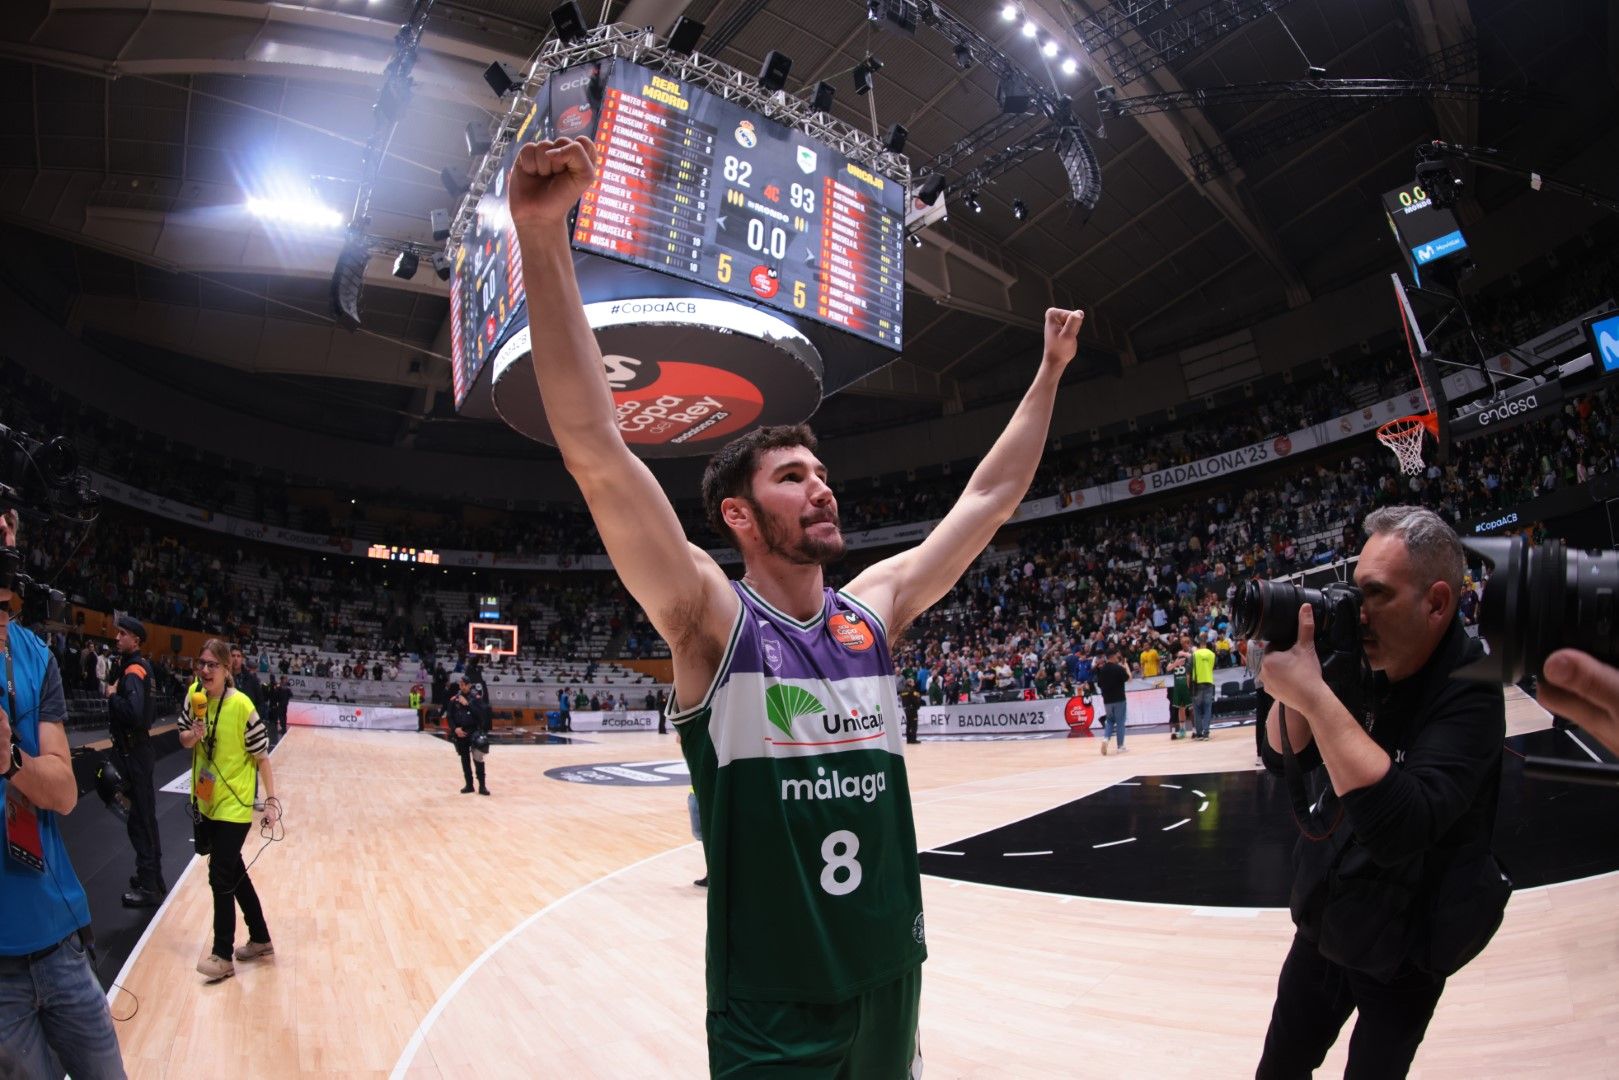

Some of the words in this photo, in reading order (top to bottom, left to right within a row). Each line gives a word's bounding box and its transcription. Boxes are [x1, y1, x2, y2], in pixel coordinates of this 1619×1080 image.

[642, 85, 689, 111] MADRID
[651, 76, 681, 96] REAL
[723, 155, 753, 188] 82
[789, 182, 815, 214] 93
[747, 218, 786, 260] 0.0
[717, 253, 732, 283] 5
[610, 301, 697, 316] #CopaACB
[793, 280, 806, 309] 5
[619, 394, 684, 432] Copa
[667, 395, 724, 423] Rey
[1478, 394, 1538, 426] endesa
[1475, 513, 1518, 533] #CopaACB
[601, 717, 651, 728] #CopaACB
[822, 704, 883, 735] Unicaj
[930, 713, 951, 727] REY
[820, 829, 863, 896] 8
